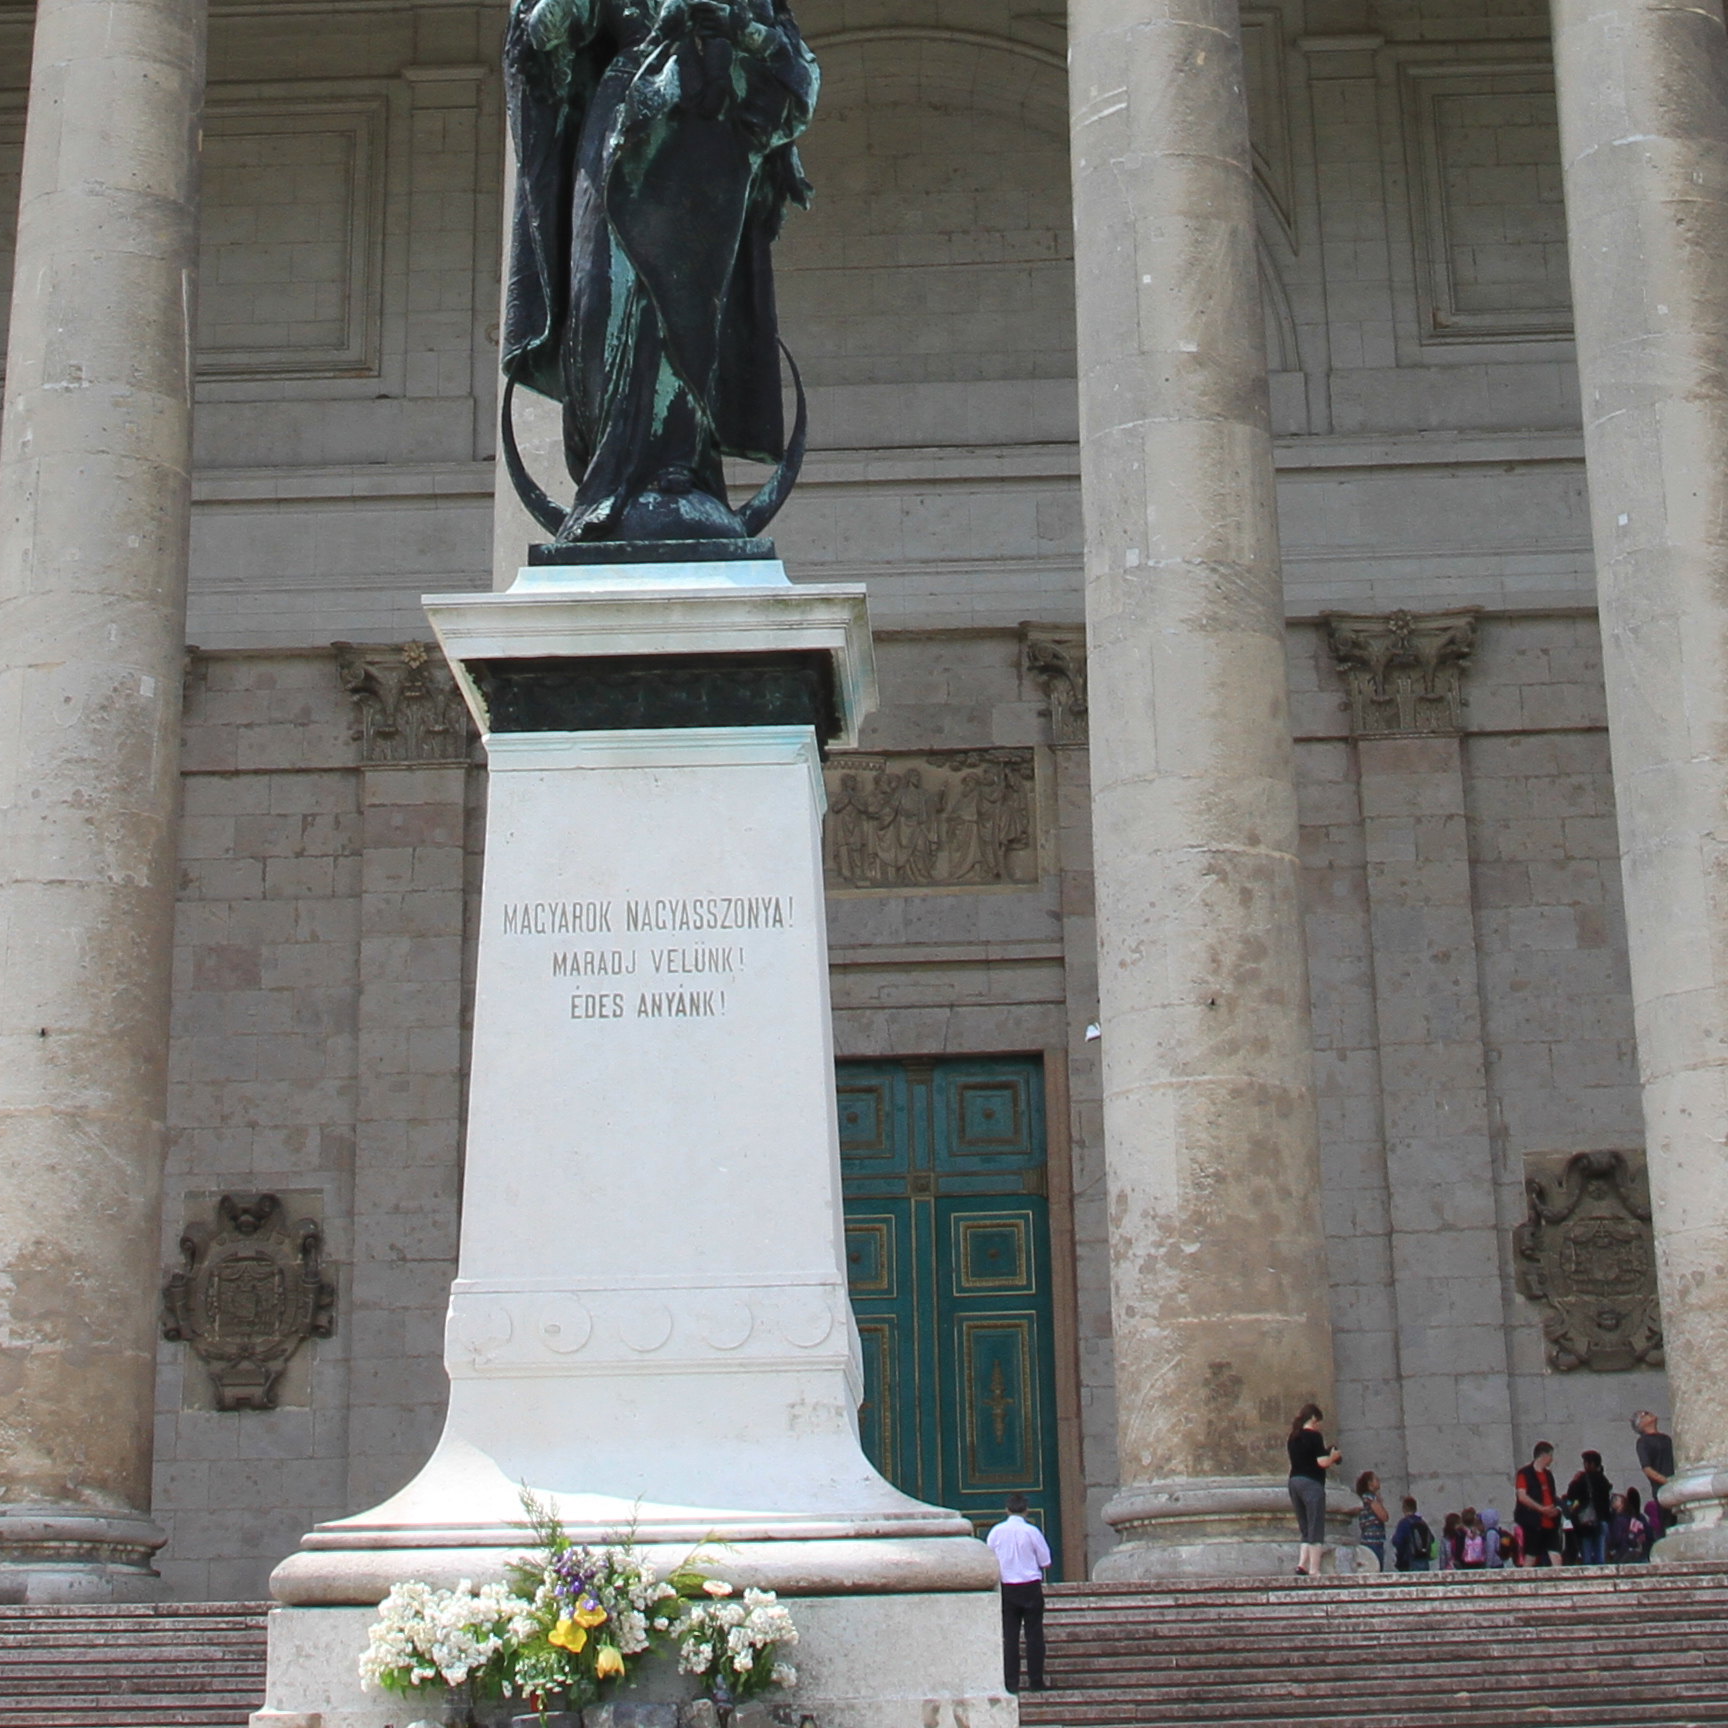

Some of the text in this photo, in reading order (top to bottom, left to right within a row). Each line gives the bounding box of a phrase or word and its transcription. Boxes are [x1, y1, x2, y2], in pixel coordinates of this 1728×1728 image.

[502, 895, 795, 935] MAGYAROK NAGYASSZONYA!
[551, 940, 745, 977] MARADJ VELÜNK!
[570, 984, 726, 1020] ÉDES ANYÁNK!
